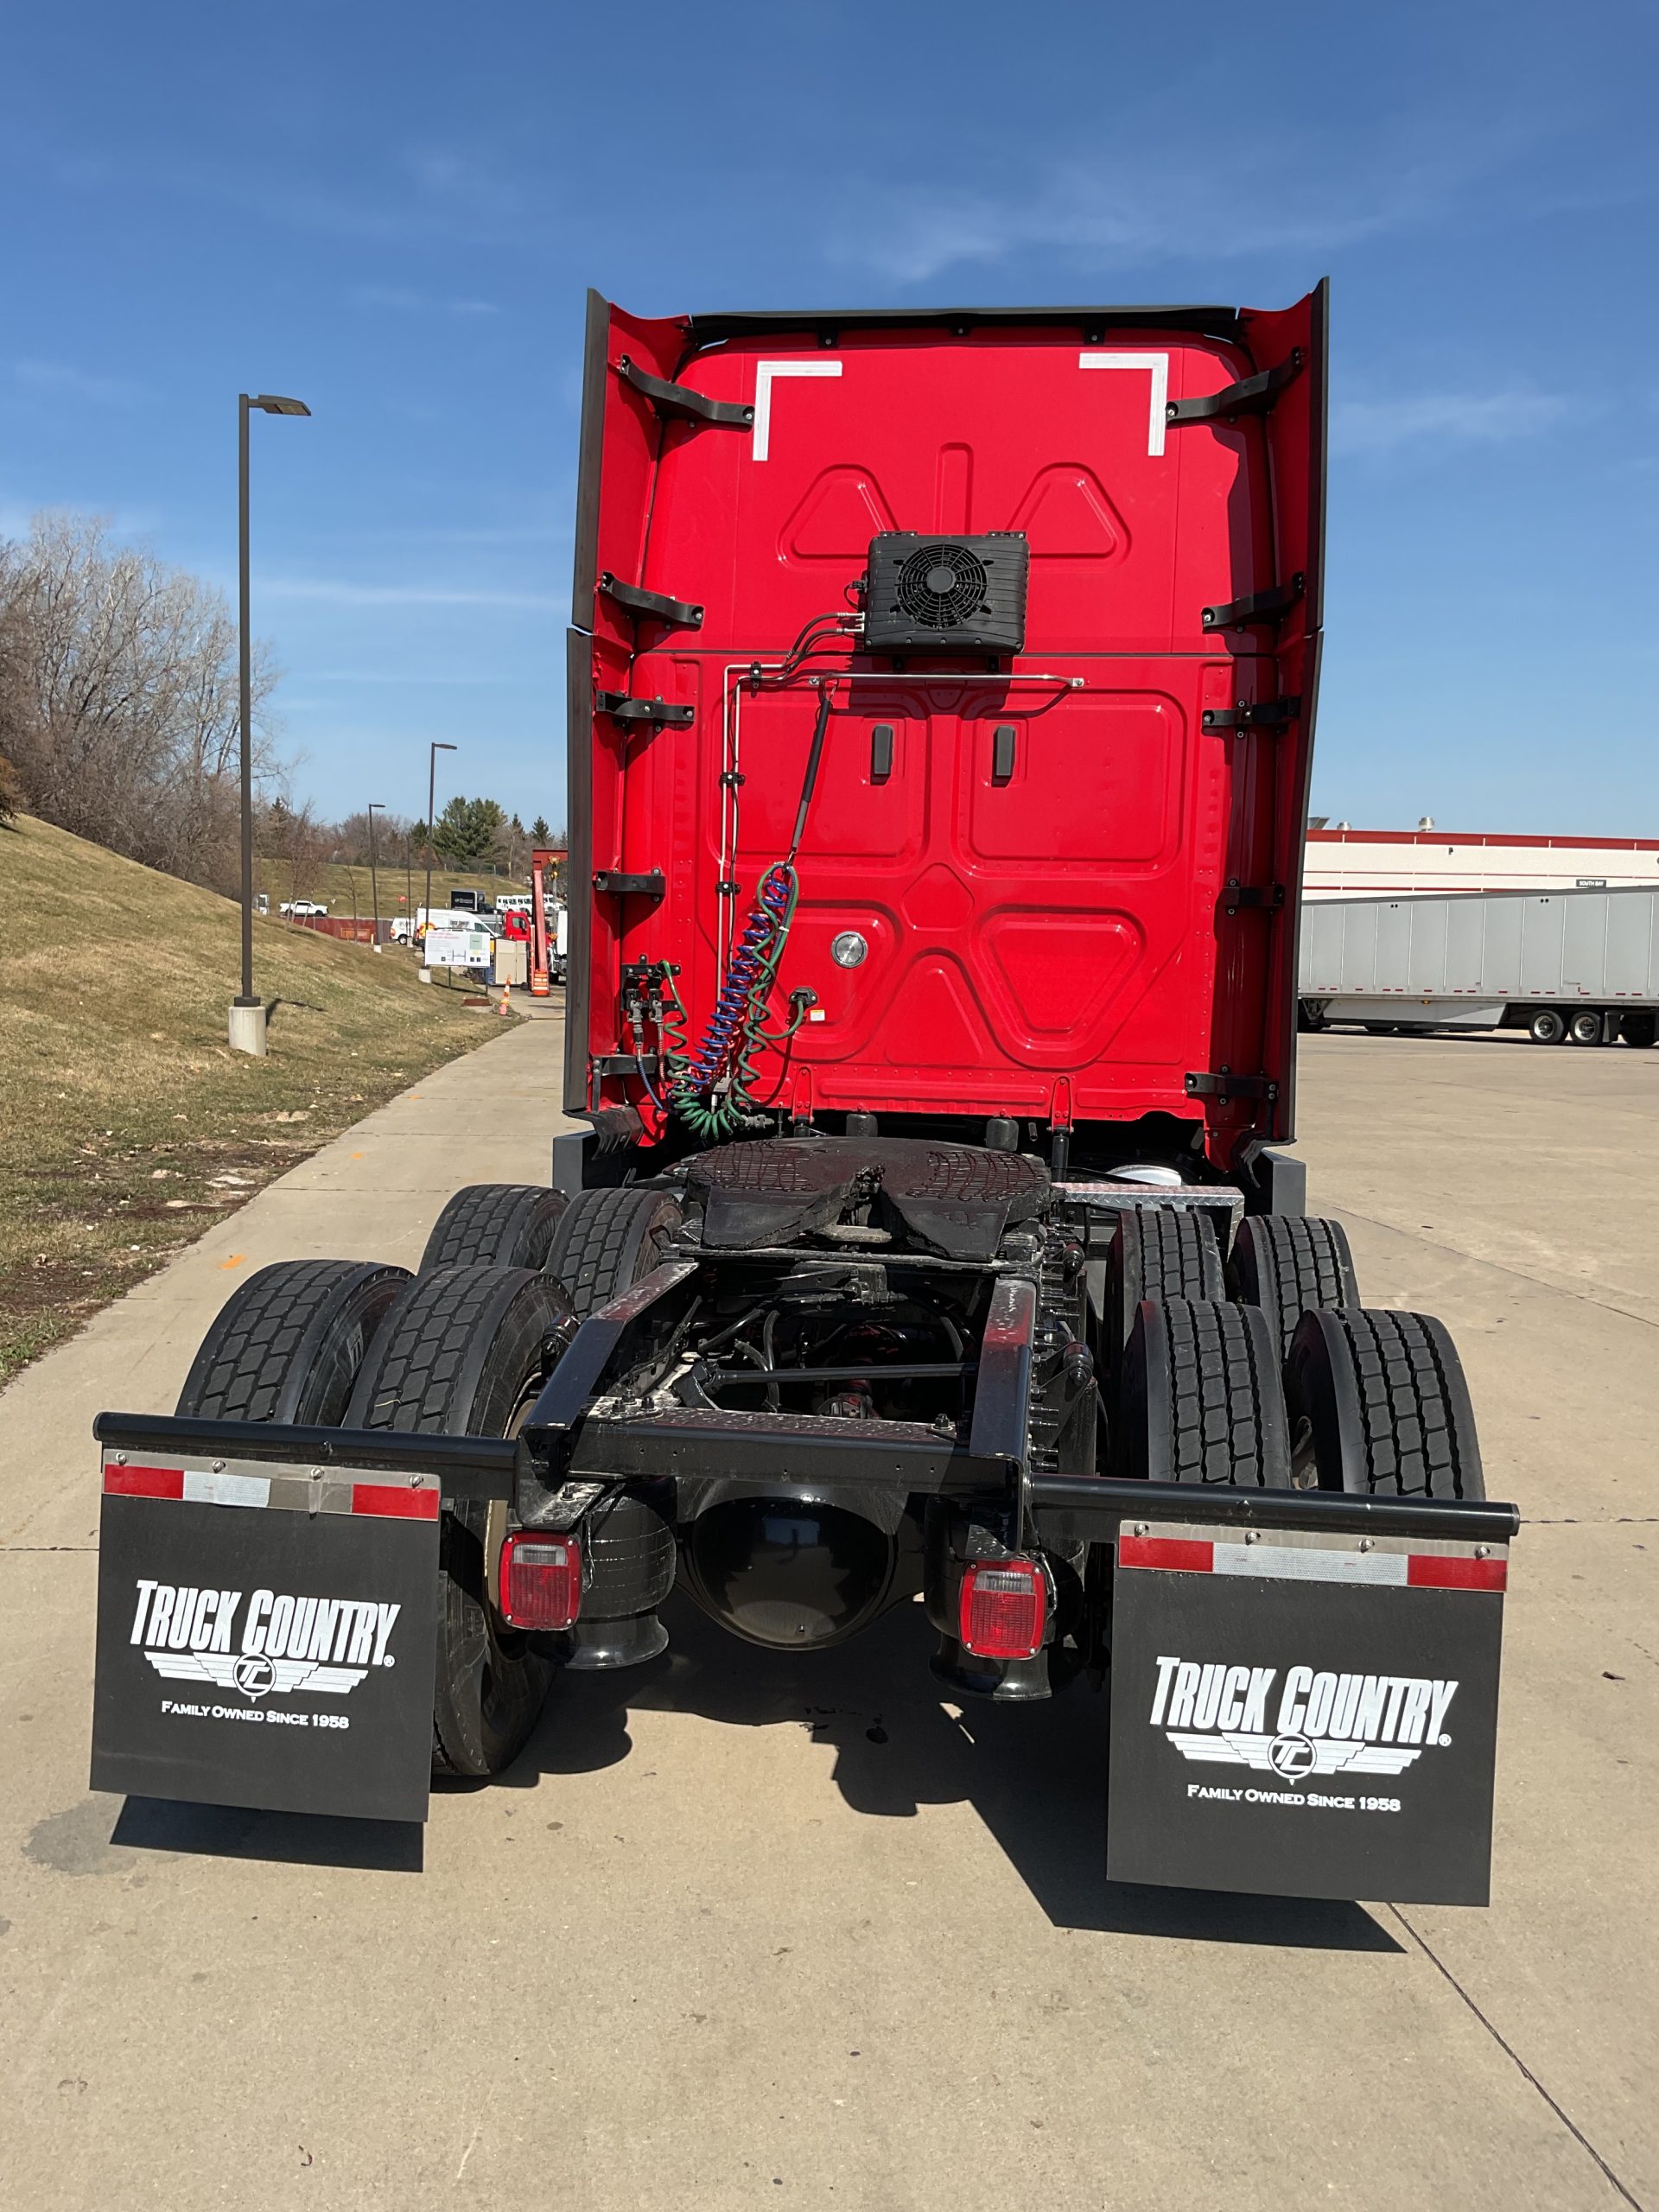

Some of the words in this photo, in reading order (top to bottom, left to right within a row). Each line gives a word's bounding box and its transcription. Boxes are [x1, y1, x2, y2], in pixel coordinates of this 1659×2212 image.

[130, 1579, 243, 1653] TRUCK
[161, 1700, 212, 1718] FAMILY
[212, 1705, 265, 1722] OWNED
[266, 1709, 309, 1726] SINCE
[312, 1713, 350, 1729] 1958
[1149, 1656, 1277, 1733] TRUCK
[1186, 1783, 1244, 1802] FAMILY
[1245, 1788, 1306, 1806] OWNED
[1306, 1793, 1356, 1810] SINCE
[1359, 1796, 1402, 1812] 1958
